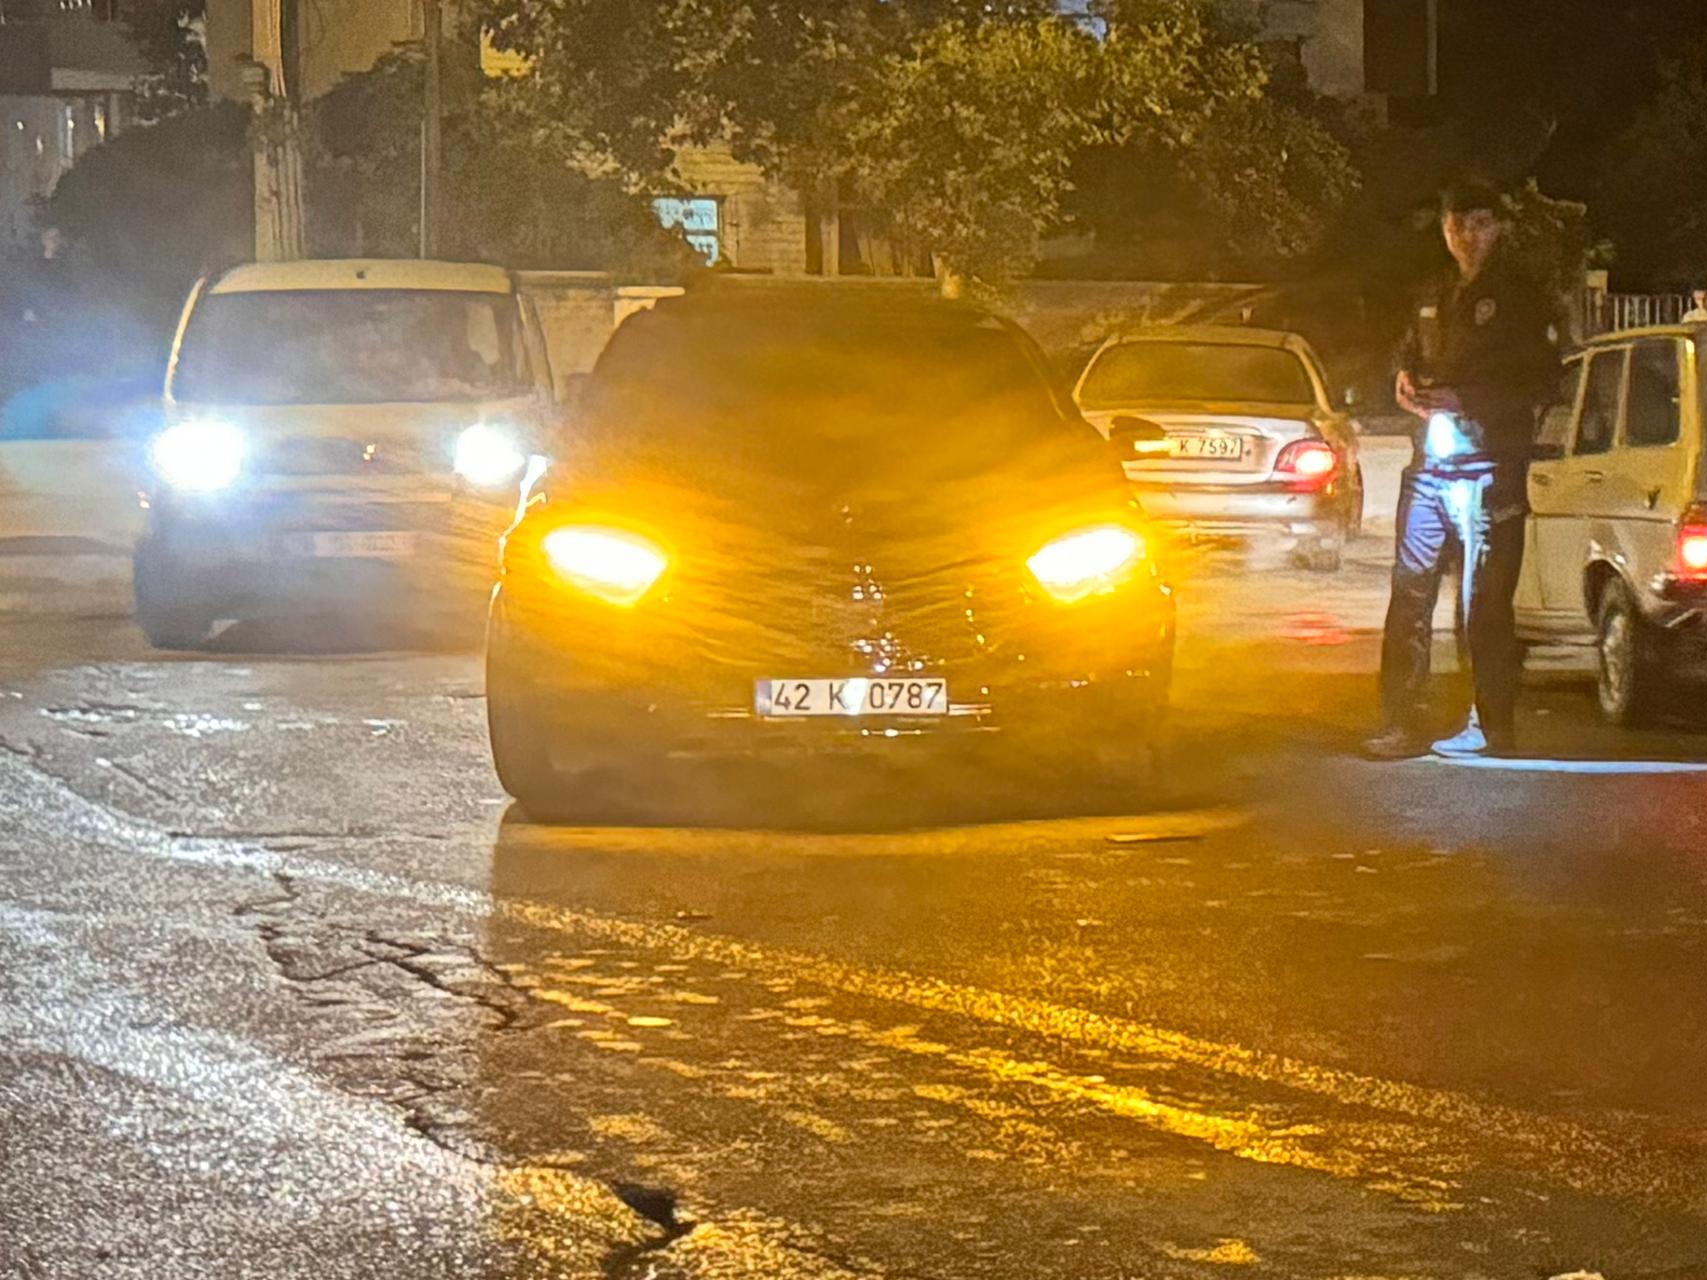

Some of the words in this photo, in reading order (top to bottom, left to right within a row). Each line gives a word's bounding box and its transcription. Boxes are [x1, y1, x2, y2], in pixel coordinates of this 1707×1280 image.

[775, 682, 811, 711] 42
[829, 683, 848, 710] K
[869, 682, 943, 709] 0787
